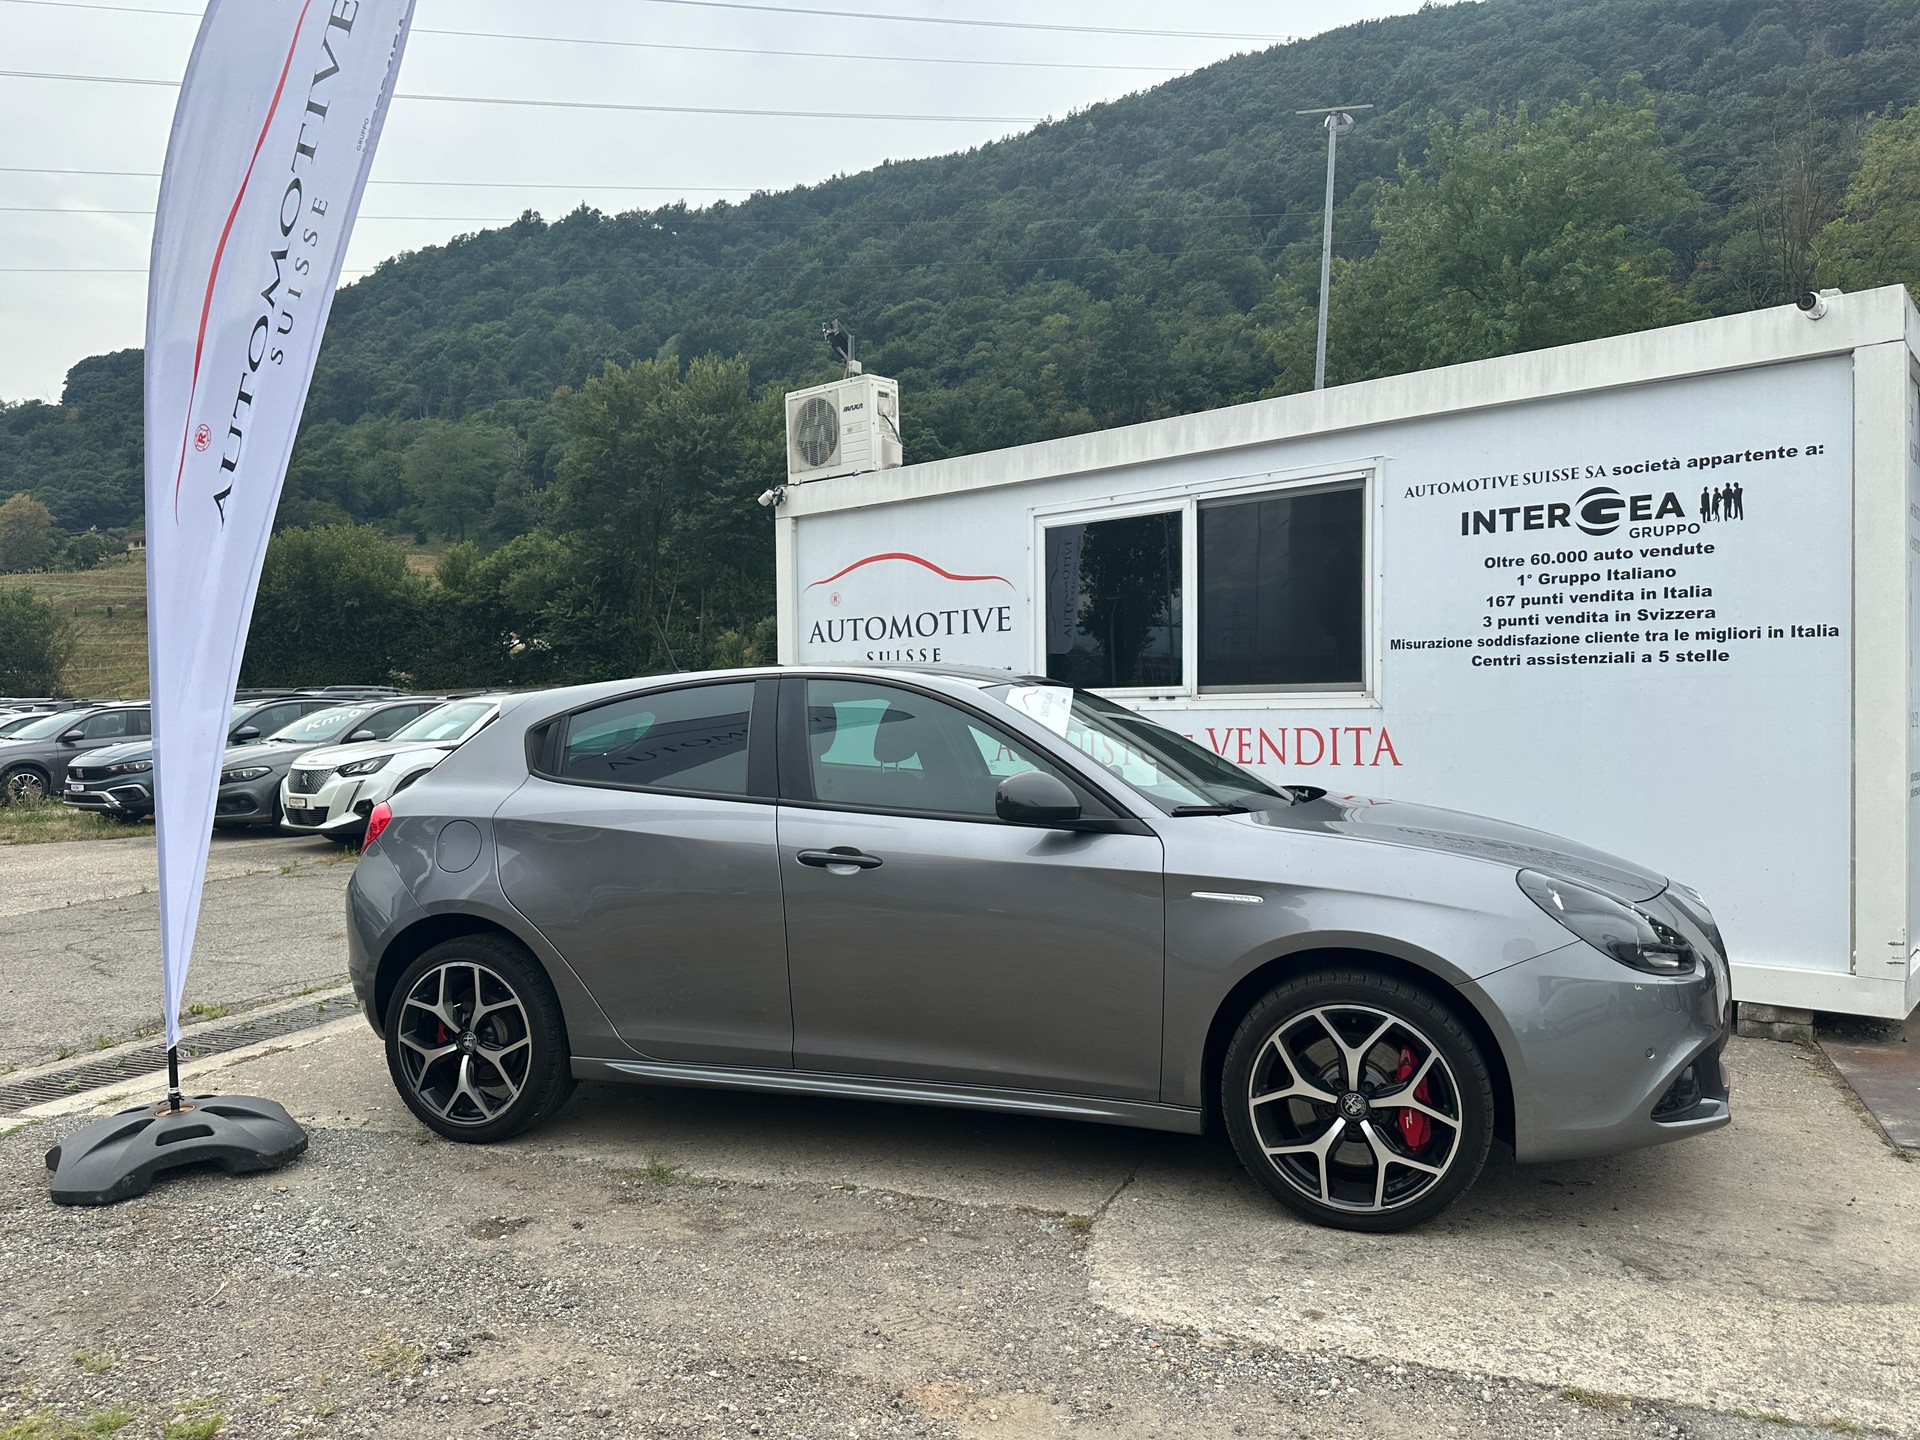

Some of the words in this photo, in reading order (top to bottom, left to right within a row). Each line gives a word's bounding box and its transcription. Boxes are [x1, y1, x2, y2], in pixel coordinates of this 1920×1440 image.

[356, 117, 369, 151] GRUPPO
[211, 0, 360, 527] AUTOMOTIVE
[270, 197, 328, 365] SUISSE
[1404, 474, 1519, 498] AUTOMOTIVE
[1522, 466, 1580, 486] SUISSE
[1584, 464, 1607, 479] SA
[1612, 457, 1681, 476] società
[1686, 445, 1799, 470] appartente
[1805, 443, 1825, 456] a:
[1628, 522, 1701, 539] GRUPPO
[1484, 555, 1526, 569] Oltre
[1530, 549, 1589, 566] 60.000
[1593, 547, 1634, 562] auto
[1639, 542, 1715, 558] vendute
[1517, 573, 1533, 587] 1°
[1538, 572, 1601, 587] Gruppo
[1607, 567, 1677, 581] Italiano
[1486, 595, 1516, 608] 167
[1520, 592, 1565, 609] punti
[1568, 589, 1635, 604] vendita
[1640, 588, 1657, 600] in
[1663, 585, 1713, 599] Italia
[808, 605, 1012, 644] AUTOMOTIVE
[1482, 616, 1493, 628] 3
[1497, 613, 1541, 630] punti
[1544, 611, 1610, 625] vendita
[1615, 609, 1631, 622] in
[1637, 606, 1716, 622] Svizzera
[1390, 637, 1473, 651] Misurazione
[1477, 633, 1581, 648] soddisfazione
[1584, 629, 1640, 645] cliente
[1645, 629, 1670, 643] tra
[1674, 628, 1690, 641] le
[1695, 625, 1762, 644] migliori
[1767, 625, 1784, 639] in
[1790, 622, 1840, 638] Italia
[1471, 653, 1521, 667] Centri
[1526, 650, 1636, 666] assistenziali
[1641, 653, 1652, 664] a
[1658, 650, 1670, 663] 5
[1675, 649, 1730, 663] stelle
[1204, 726, 1403, 767] VENDITA
